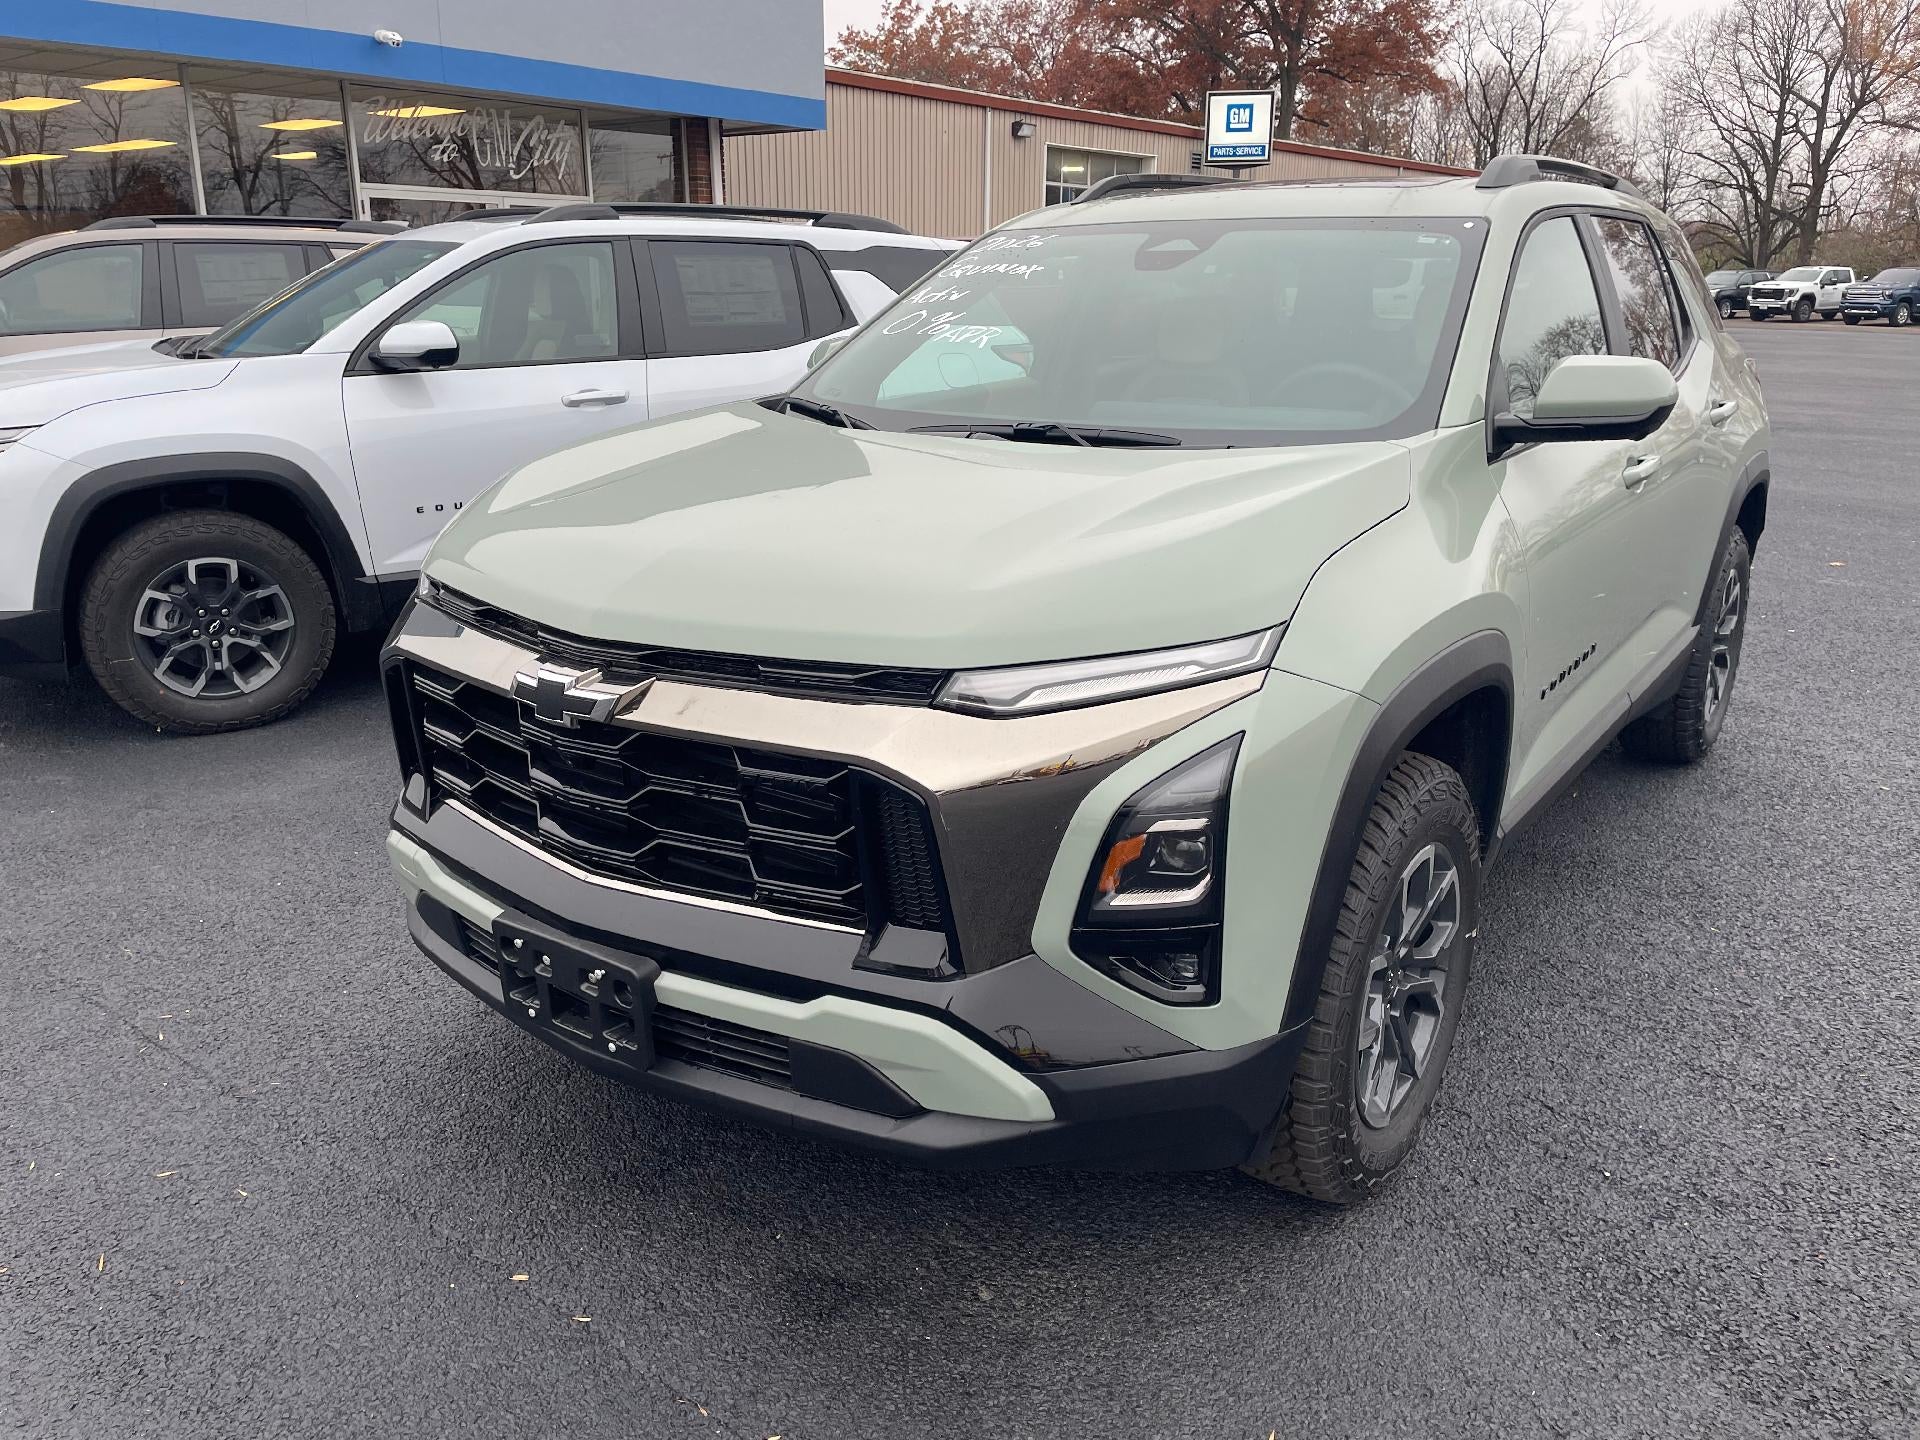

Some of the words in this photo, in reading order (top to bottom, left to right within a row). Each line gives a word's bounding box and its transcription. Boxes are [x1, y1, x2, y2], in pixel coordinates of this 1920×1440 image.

[1230, 108, 1250, 124] GM
[361, 96, 469, 143] Welcome
[431, 135, 459, 162] to
[473, 107, 515, 167] GM
[510, 115, 574, 180] City
[934, 325, 1002, 348] APR
